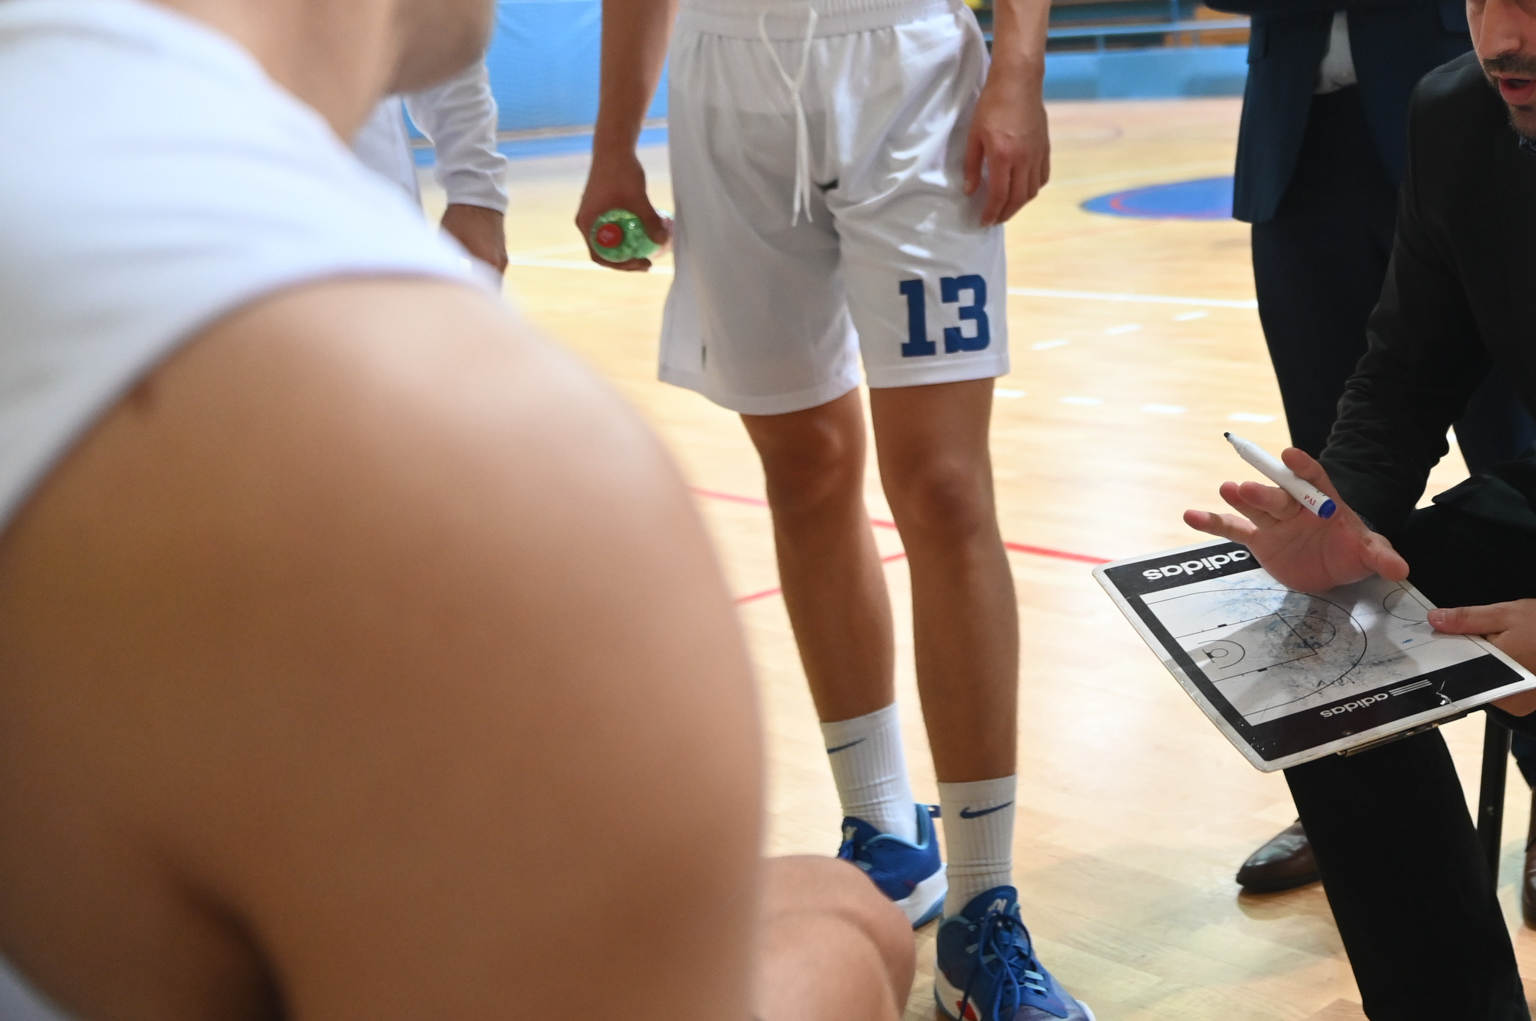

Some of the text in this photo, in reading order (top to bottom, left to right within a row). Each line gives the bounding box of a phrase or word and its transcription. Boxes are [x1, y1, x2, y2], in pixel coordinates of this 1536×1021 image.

[899, 274, 990, 357] 13
[1142, 549, 1250, 580] adidas
[1319, 691, 1388, 718] adidas
